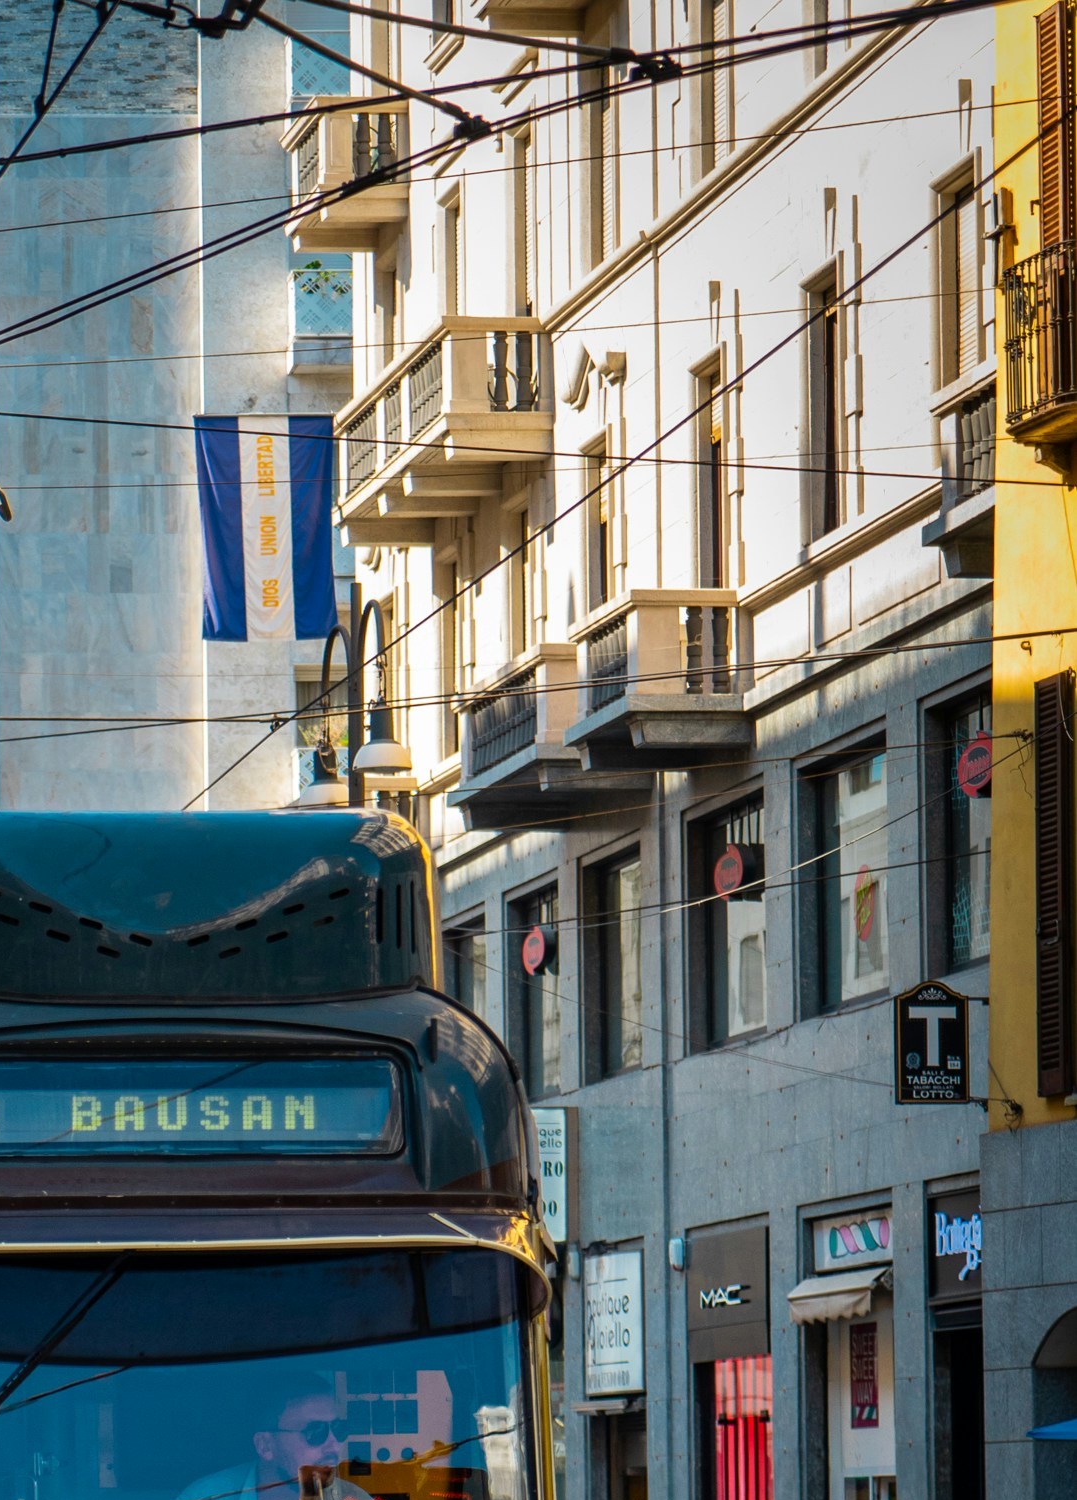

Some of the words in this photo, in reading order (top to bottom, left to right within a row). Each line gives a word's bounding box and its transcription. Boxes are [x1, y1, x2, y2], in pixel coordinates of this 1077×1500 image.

[257, 435, 275, 497] LIBERTAD
[260, 516, 277, 556] UNION
[262, 578, 279, 608] DIOS
[908, 1006, 956, 1067] T
[907, 1075, 960, 1085] TABACCHI
[913, 1090, 953, 1099] LOTTO
[72, 1094, 315, 1131] BAUSAN
[700, 1284, 742, 1310] MAC
